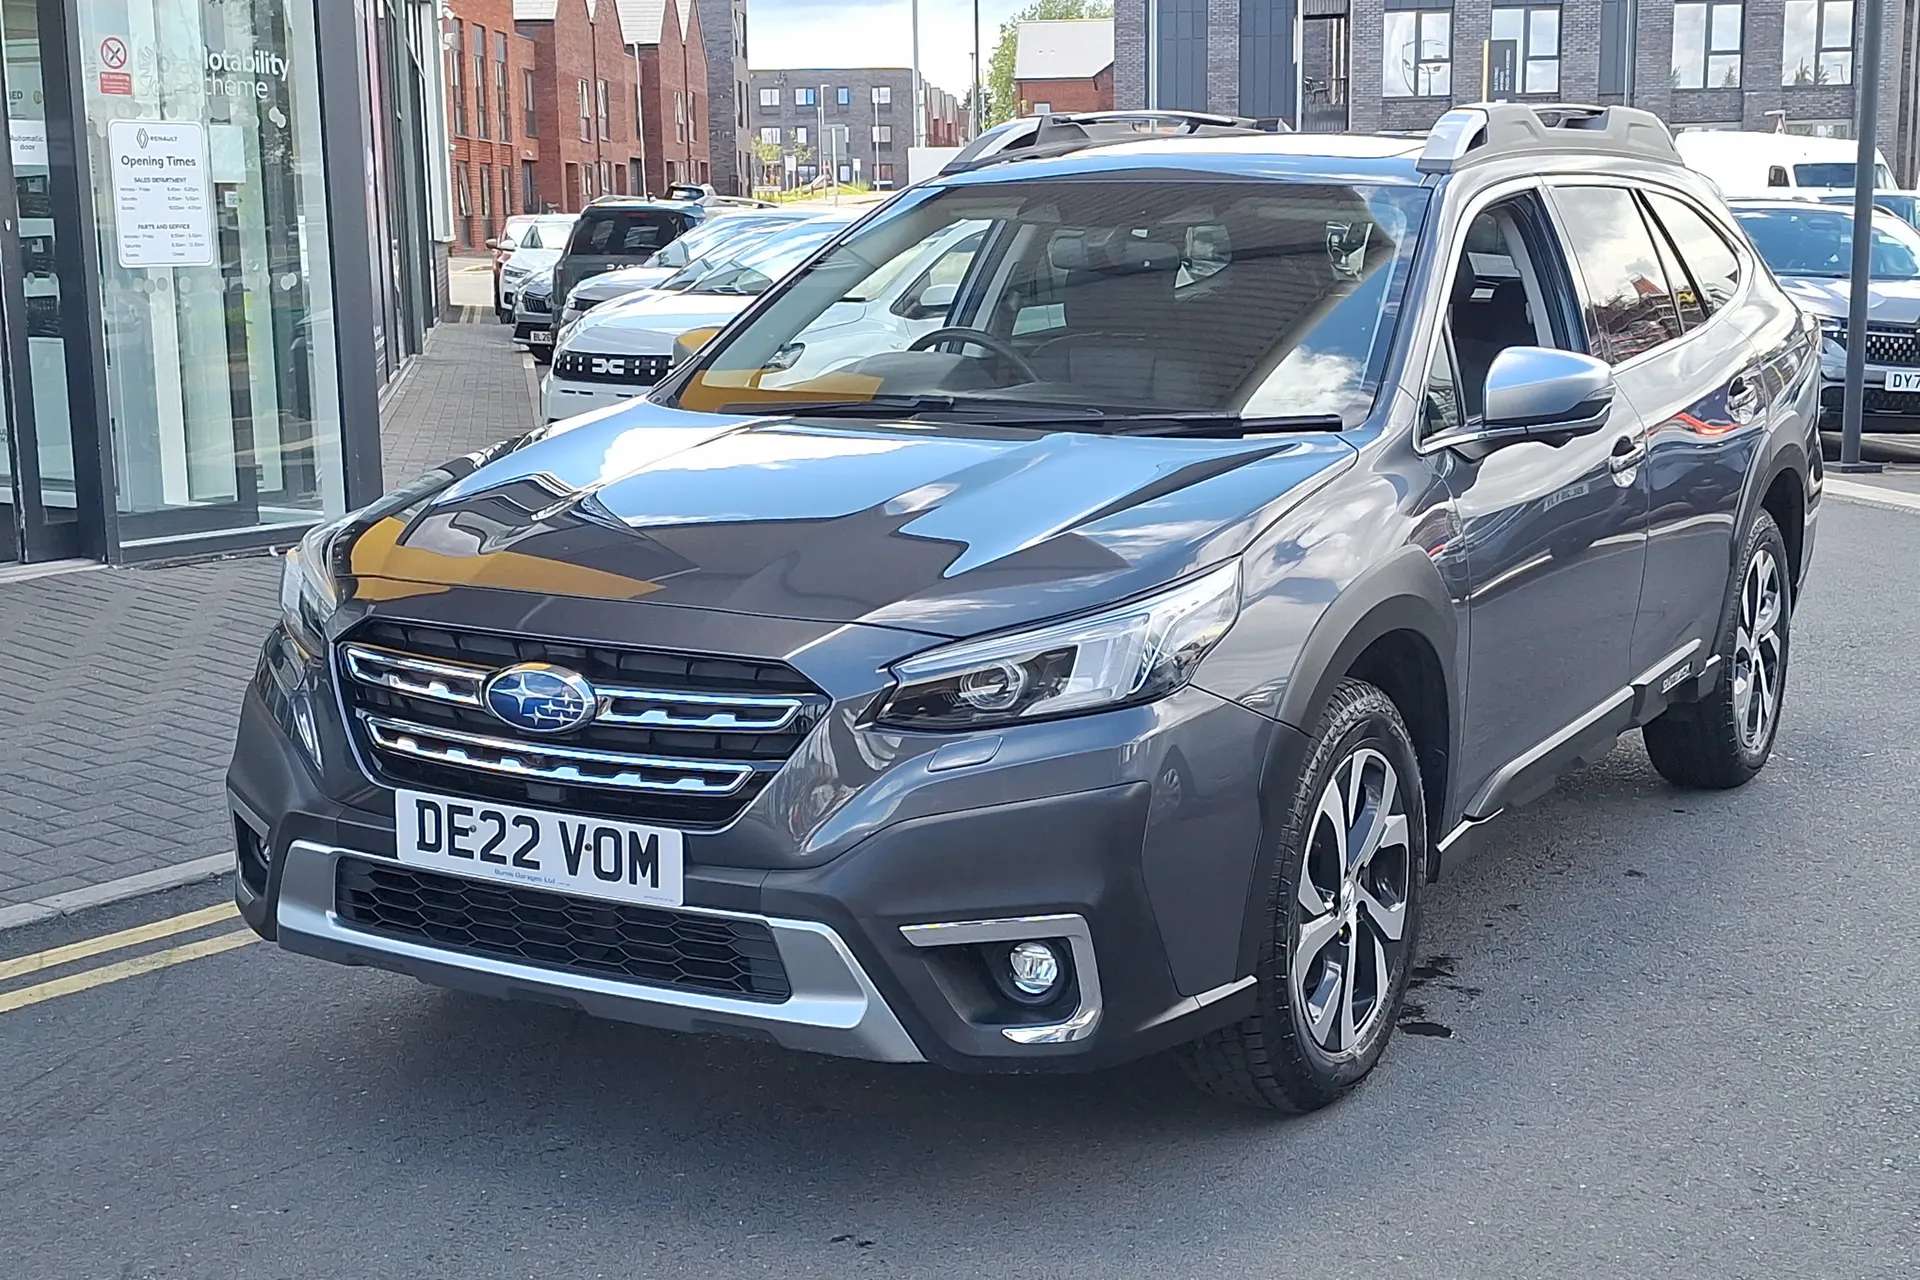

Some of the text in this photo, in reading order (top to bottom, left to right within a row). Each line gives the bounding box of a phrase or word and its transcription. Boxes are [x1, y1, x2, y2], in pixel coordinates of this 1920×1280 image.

[204, 72, 268, 98] cheme
[121, 155, 196, 169] Opening Times
[415, 798, 660, 889] DE22 VOM
